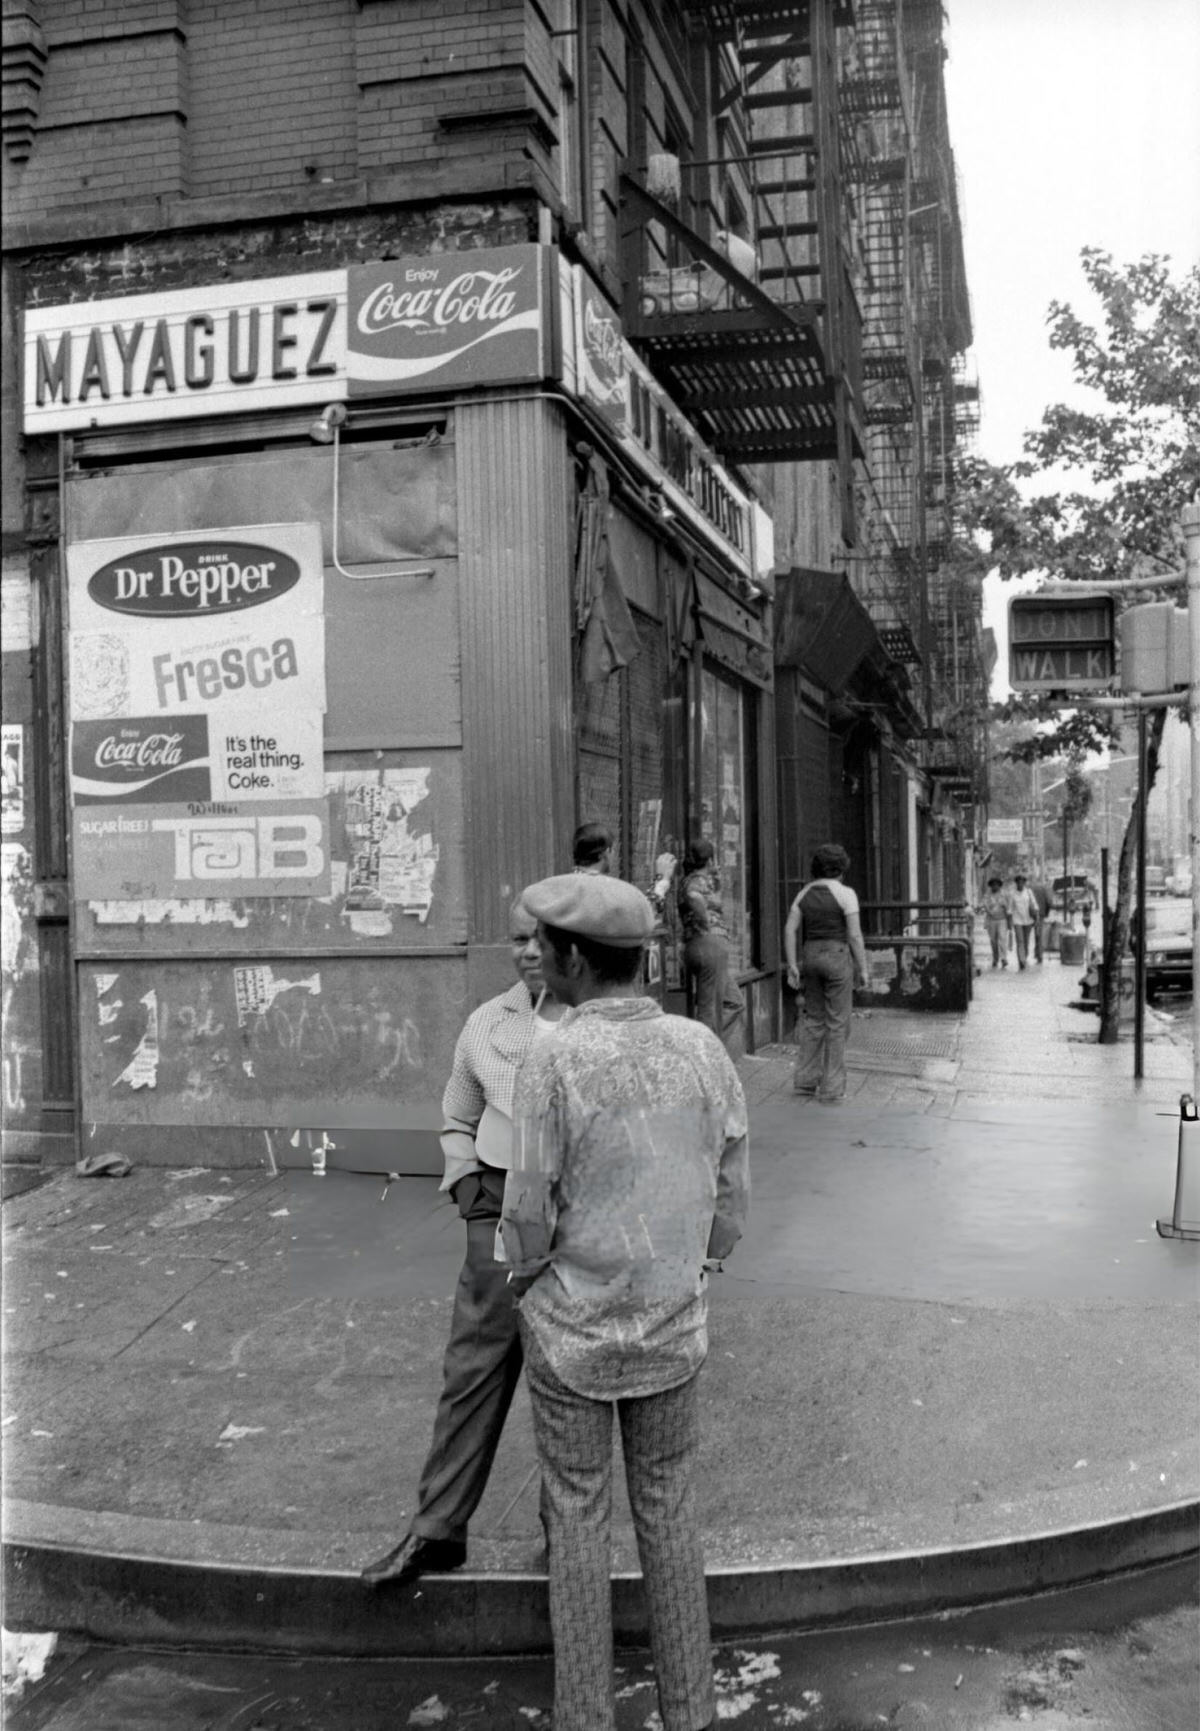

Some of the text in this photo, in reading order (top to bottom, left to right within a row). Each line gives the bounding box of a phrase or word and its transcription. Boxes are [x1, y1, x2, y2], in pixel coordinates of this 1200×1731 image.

[405, 268, 440, 282] Enjoy
[357, 265, 524, 334] Coca-Cola
[36, 298, 337, 407] MAYAGUEZ
[198, 554, 229, 564] DRINK
[114, 556, 276, 607] Dr Pepper
[152, 637, 299, 709] Fresca
[1016, 650, 1104, 680] WALK
[95, 732, 185, 768] Coca-Cola
[226, 735, 277, 752] It's the
[227, 751, 304, 770] real thing.
[228, 772, 274, 790] Coke.
